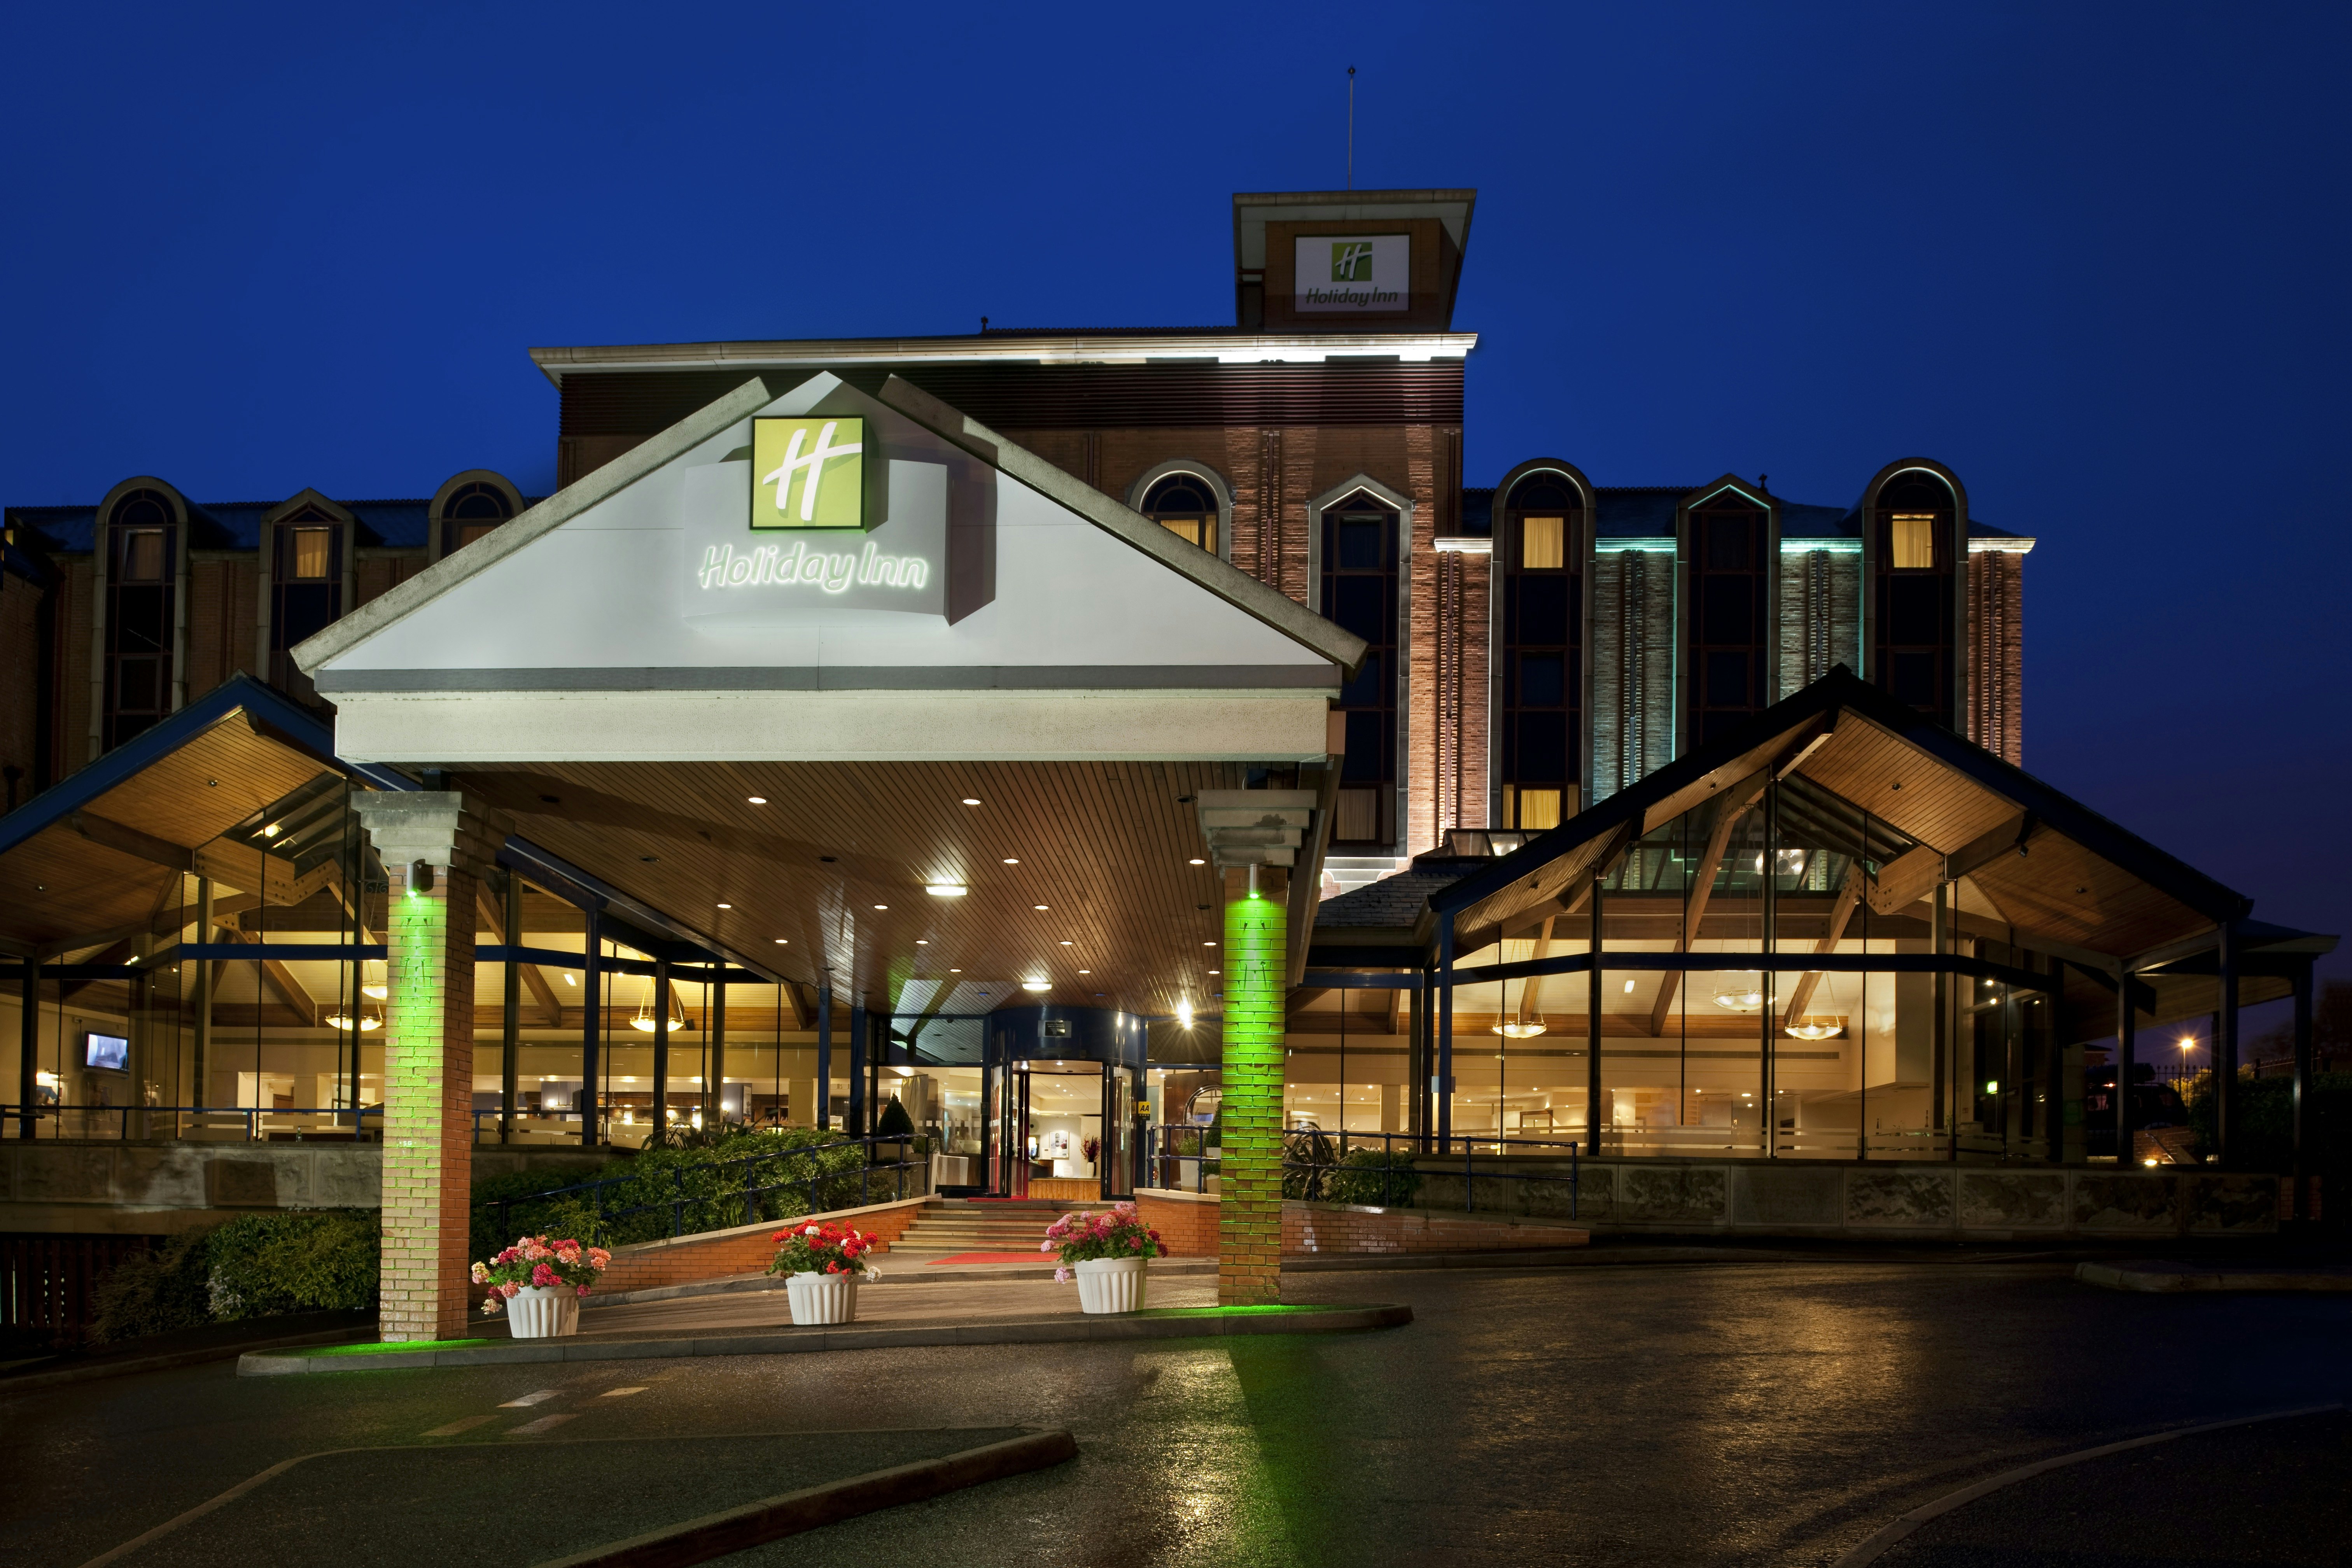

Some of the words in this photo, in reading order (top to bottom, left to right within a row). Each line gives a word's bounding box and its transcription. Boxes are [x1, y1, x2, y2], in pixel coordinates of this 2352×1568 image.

[1306, 288, 1370, 307] Holiday
[1372, 287, 1398, 303] Inn
[699, 542, 855, 592] Holiday
[860, 542, 928, 588] Inn
